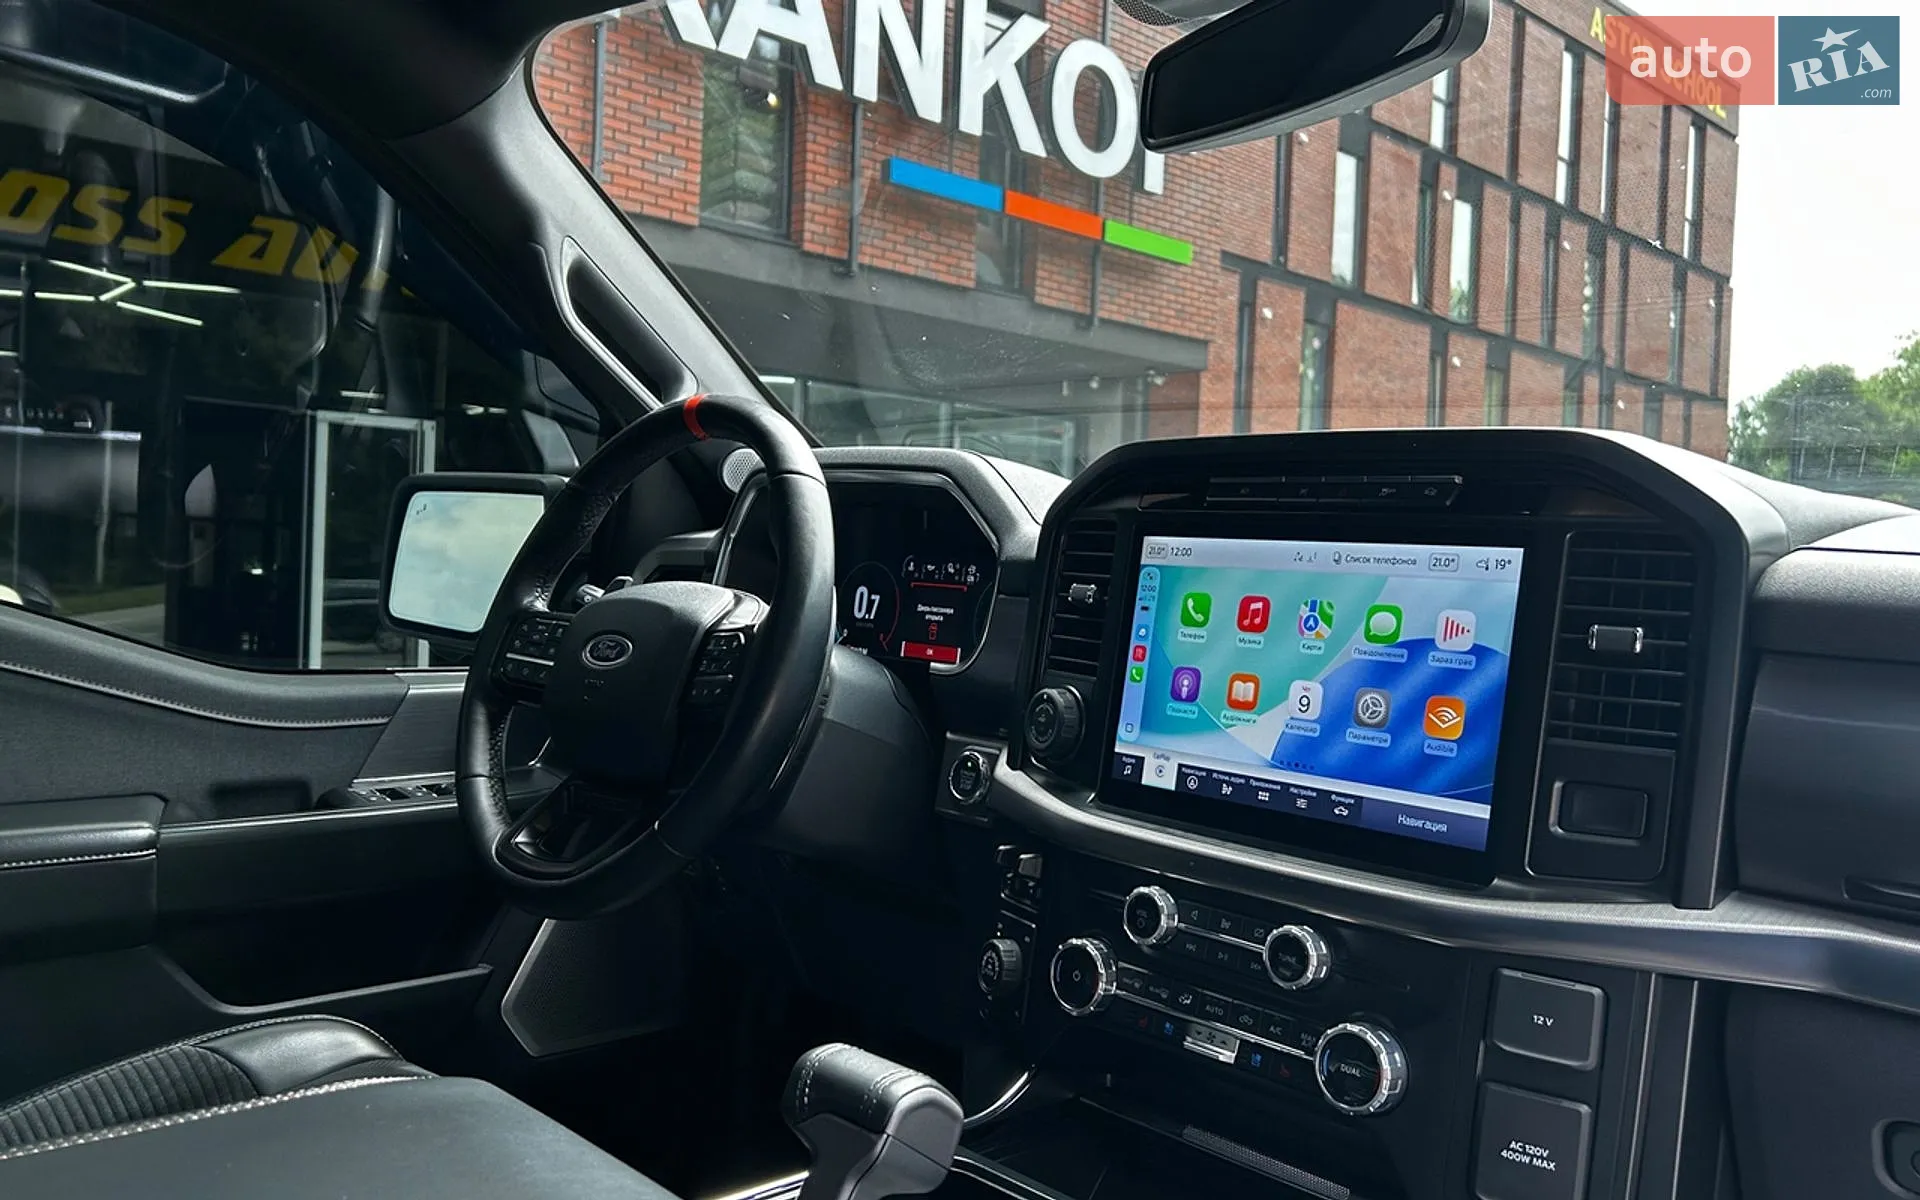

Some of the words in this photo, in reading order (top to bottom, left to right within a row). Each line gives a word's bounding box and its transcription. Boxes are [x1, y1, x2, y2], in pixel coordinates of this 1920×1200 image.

[661, 0, 1165, 195] ANKO
[1170, 548, 1192, 557] 12:00
[1345, 554, 1371, 564] Список
[1373, 556, 1418, 566] телефонов
[853, 585, 880, 619] 0.7
[1179, 630, 1205, 640] Телефон
[1298, 695, 1310, 713] 9
[1426, 742, 1455, 753] Audible
[1398, 814, 1448, 833] Навигация
[1205, 1004, 1224, 1016] AUTO
[1533, 1014, 1543, 1025] 12
[1545, 1017, 1553, 1026] V
[1341, 1064, 1361, 1077] DUAL
[1509, 1140, 1524, 1152] AC
[1525, 1144, 1549, 1158] 120V
[1501, 1149, 1531, 1164] 400W
[1532, 1157, 1556, 1171] MAX
